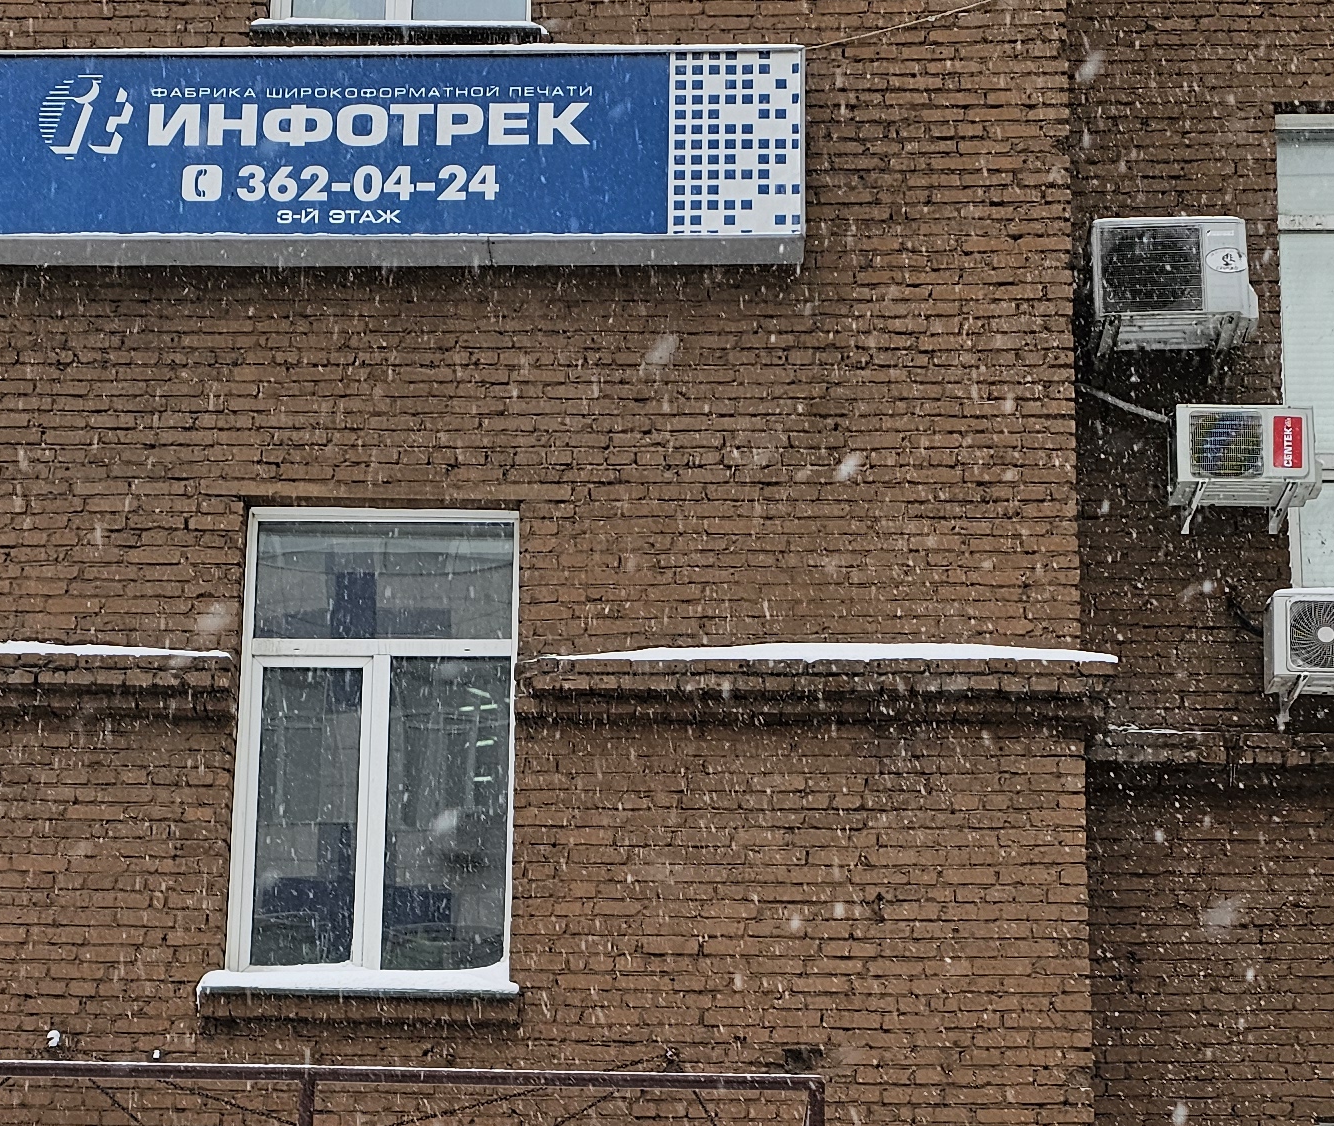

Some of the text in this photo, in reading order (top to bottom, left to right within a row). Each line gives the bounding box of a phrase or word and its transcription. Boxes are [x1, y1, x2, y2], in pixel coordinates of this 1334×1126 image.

[151, 86, 593, 98] ФАБРИКА ШИРОКОФОРМАТНОЙ ПЕЧАТИ
[148, 103, 591, 147] ИНФОТРЕК
[236, 164, 500, 202] 362-04-24
[276, 208, 402, 224] 3-Й ЭТАЖ
[1284, 427, 1293, 467] CENTEK
